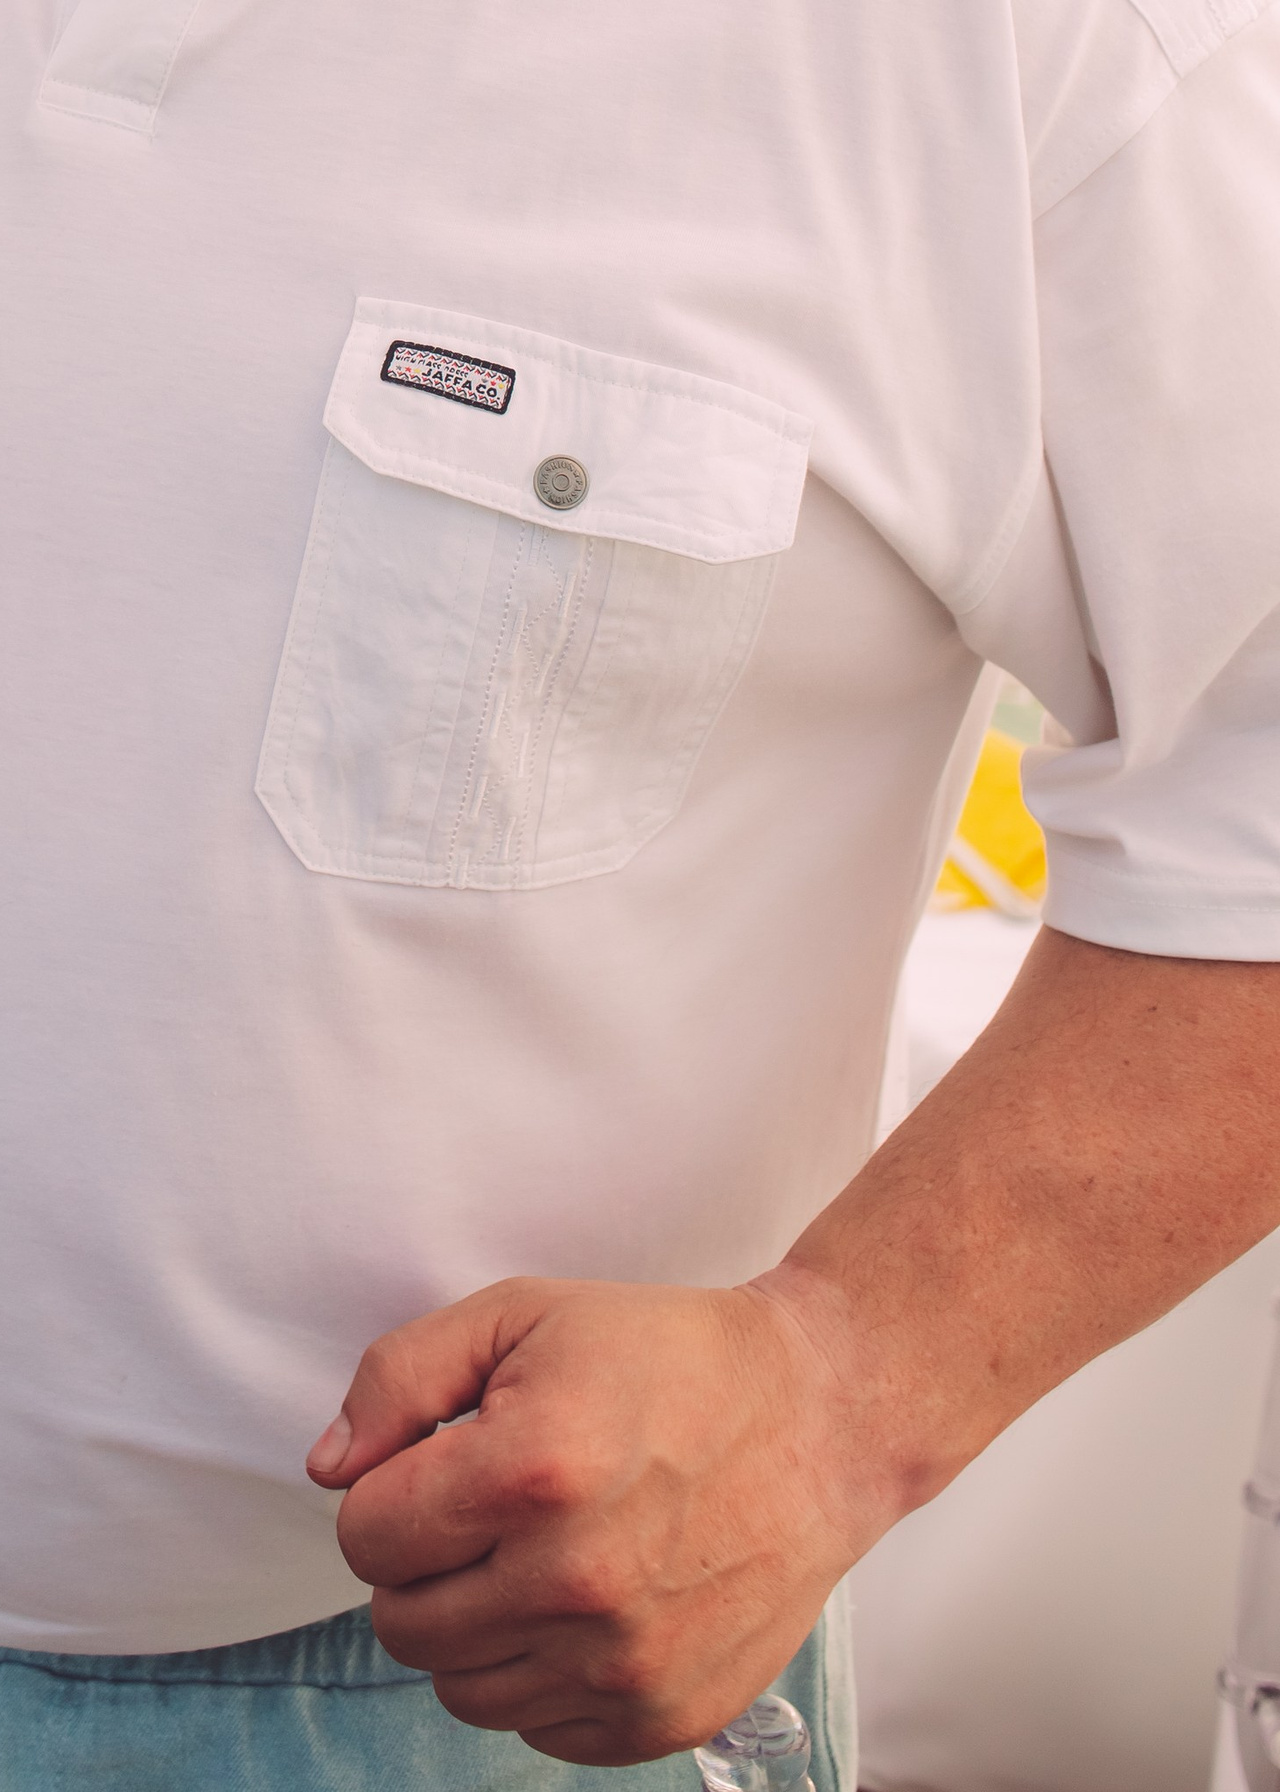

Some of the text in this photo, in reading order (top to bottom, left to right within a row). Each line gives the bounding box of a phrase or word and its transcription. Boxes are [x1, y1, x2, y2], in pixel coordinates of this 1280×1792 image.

[421, 368, 501, 400] JAFFA CO.
[539, 460, 574, 486] FASHION
